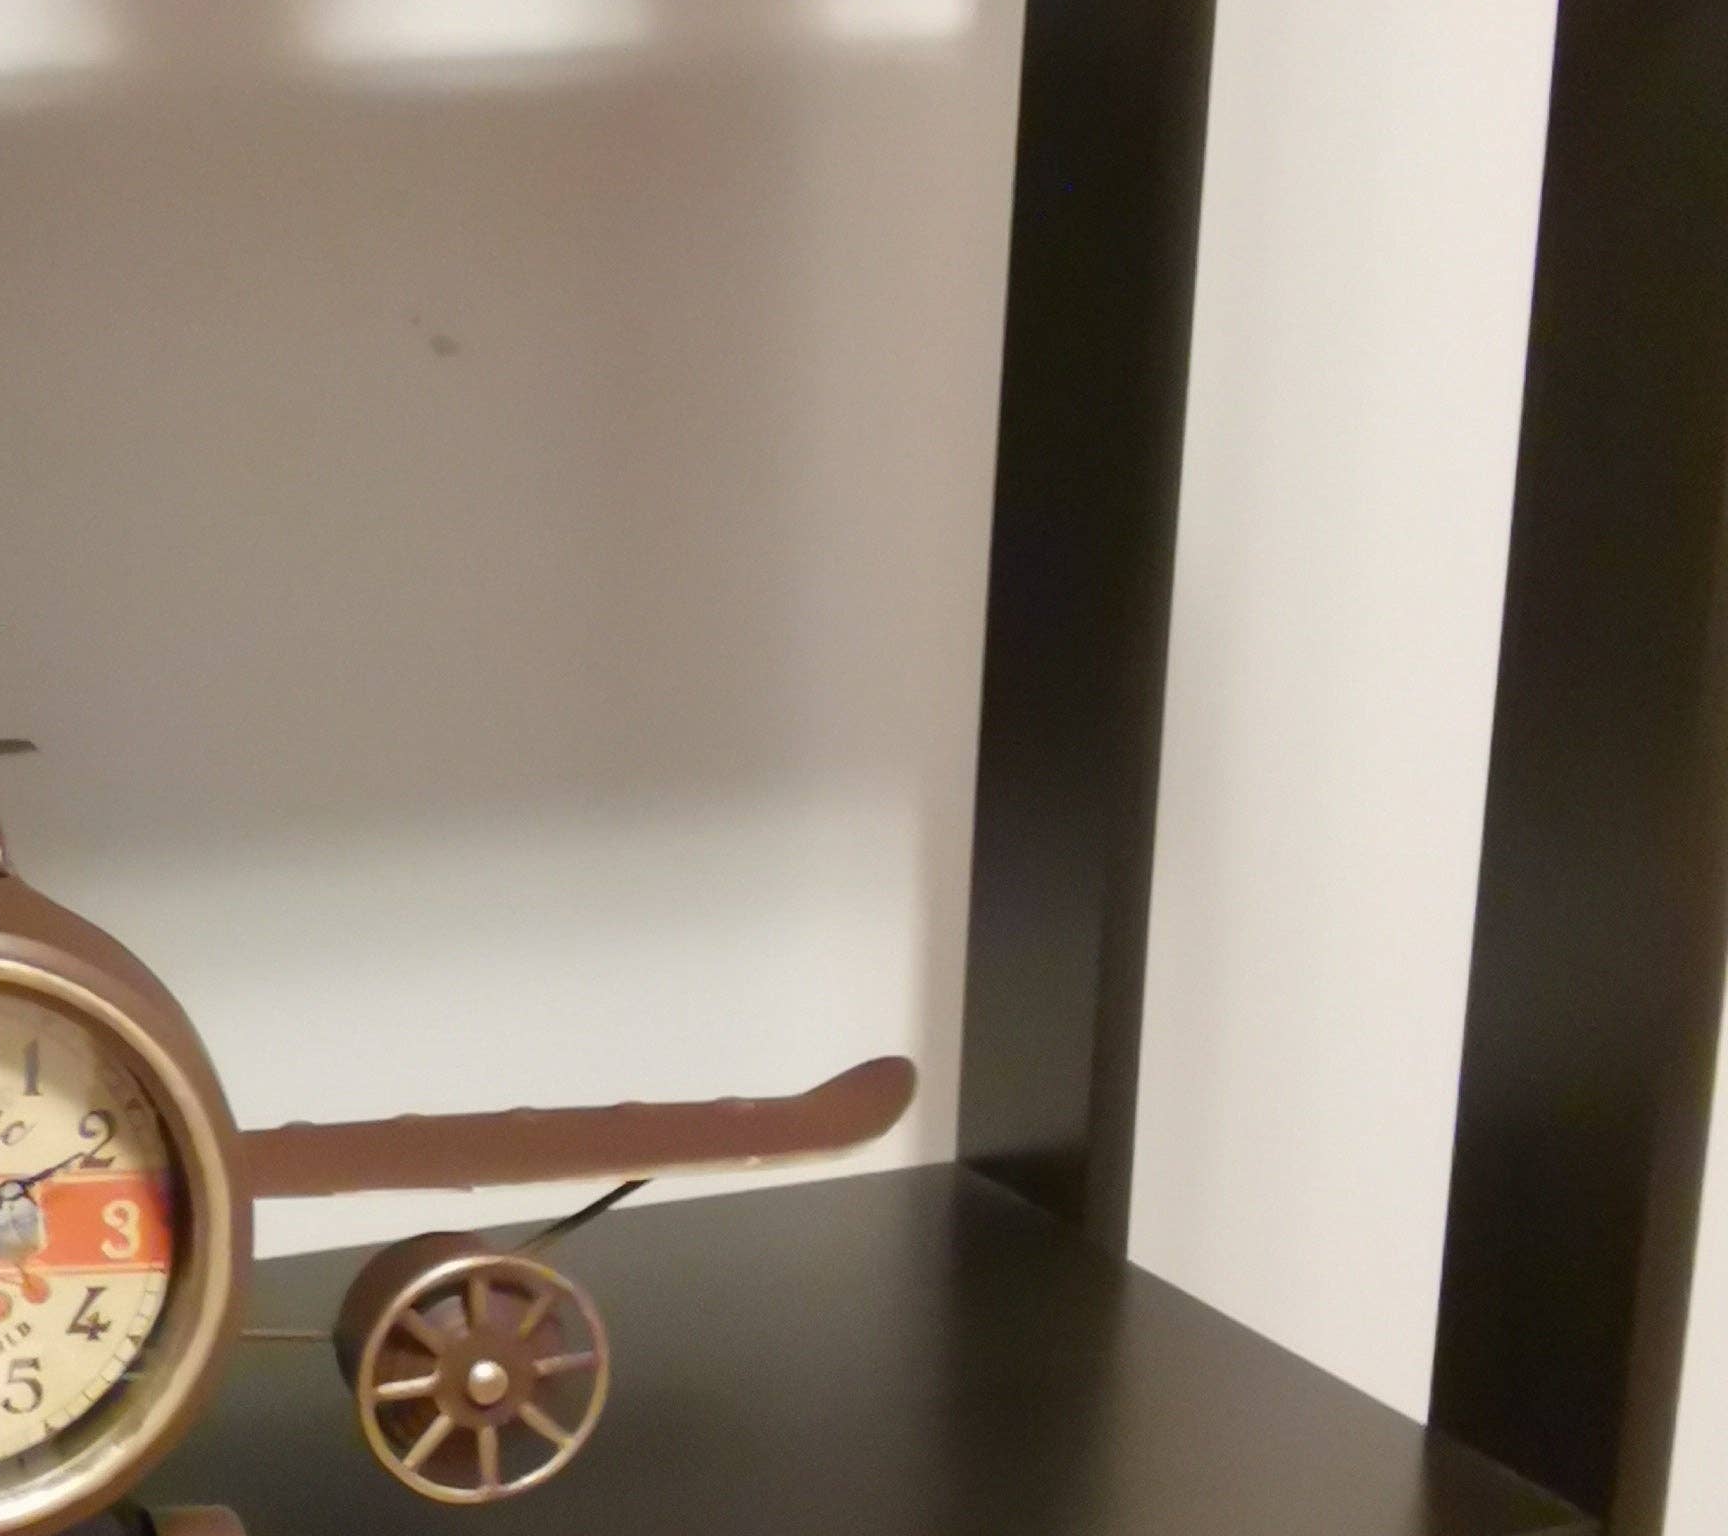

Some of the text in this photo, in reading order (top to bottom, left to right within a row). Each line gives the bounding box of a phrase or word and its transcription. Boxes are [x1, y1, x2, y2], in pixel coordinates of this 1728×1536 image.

[22, 1037, 42, 1096] 1
[78, 1109, 117, 1169] 2
[100, 1199, 141, 1260] 3
[66, 1285, 113, 1342] 4
[2, 1357, 44, 1414] 5
